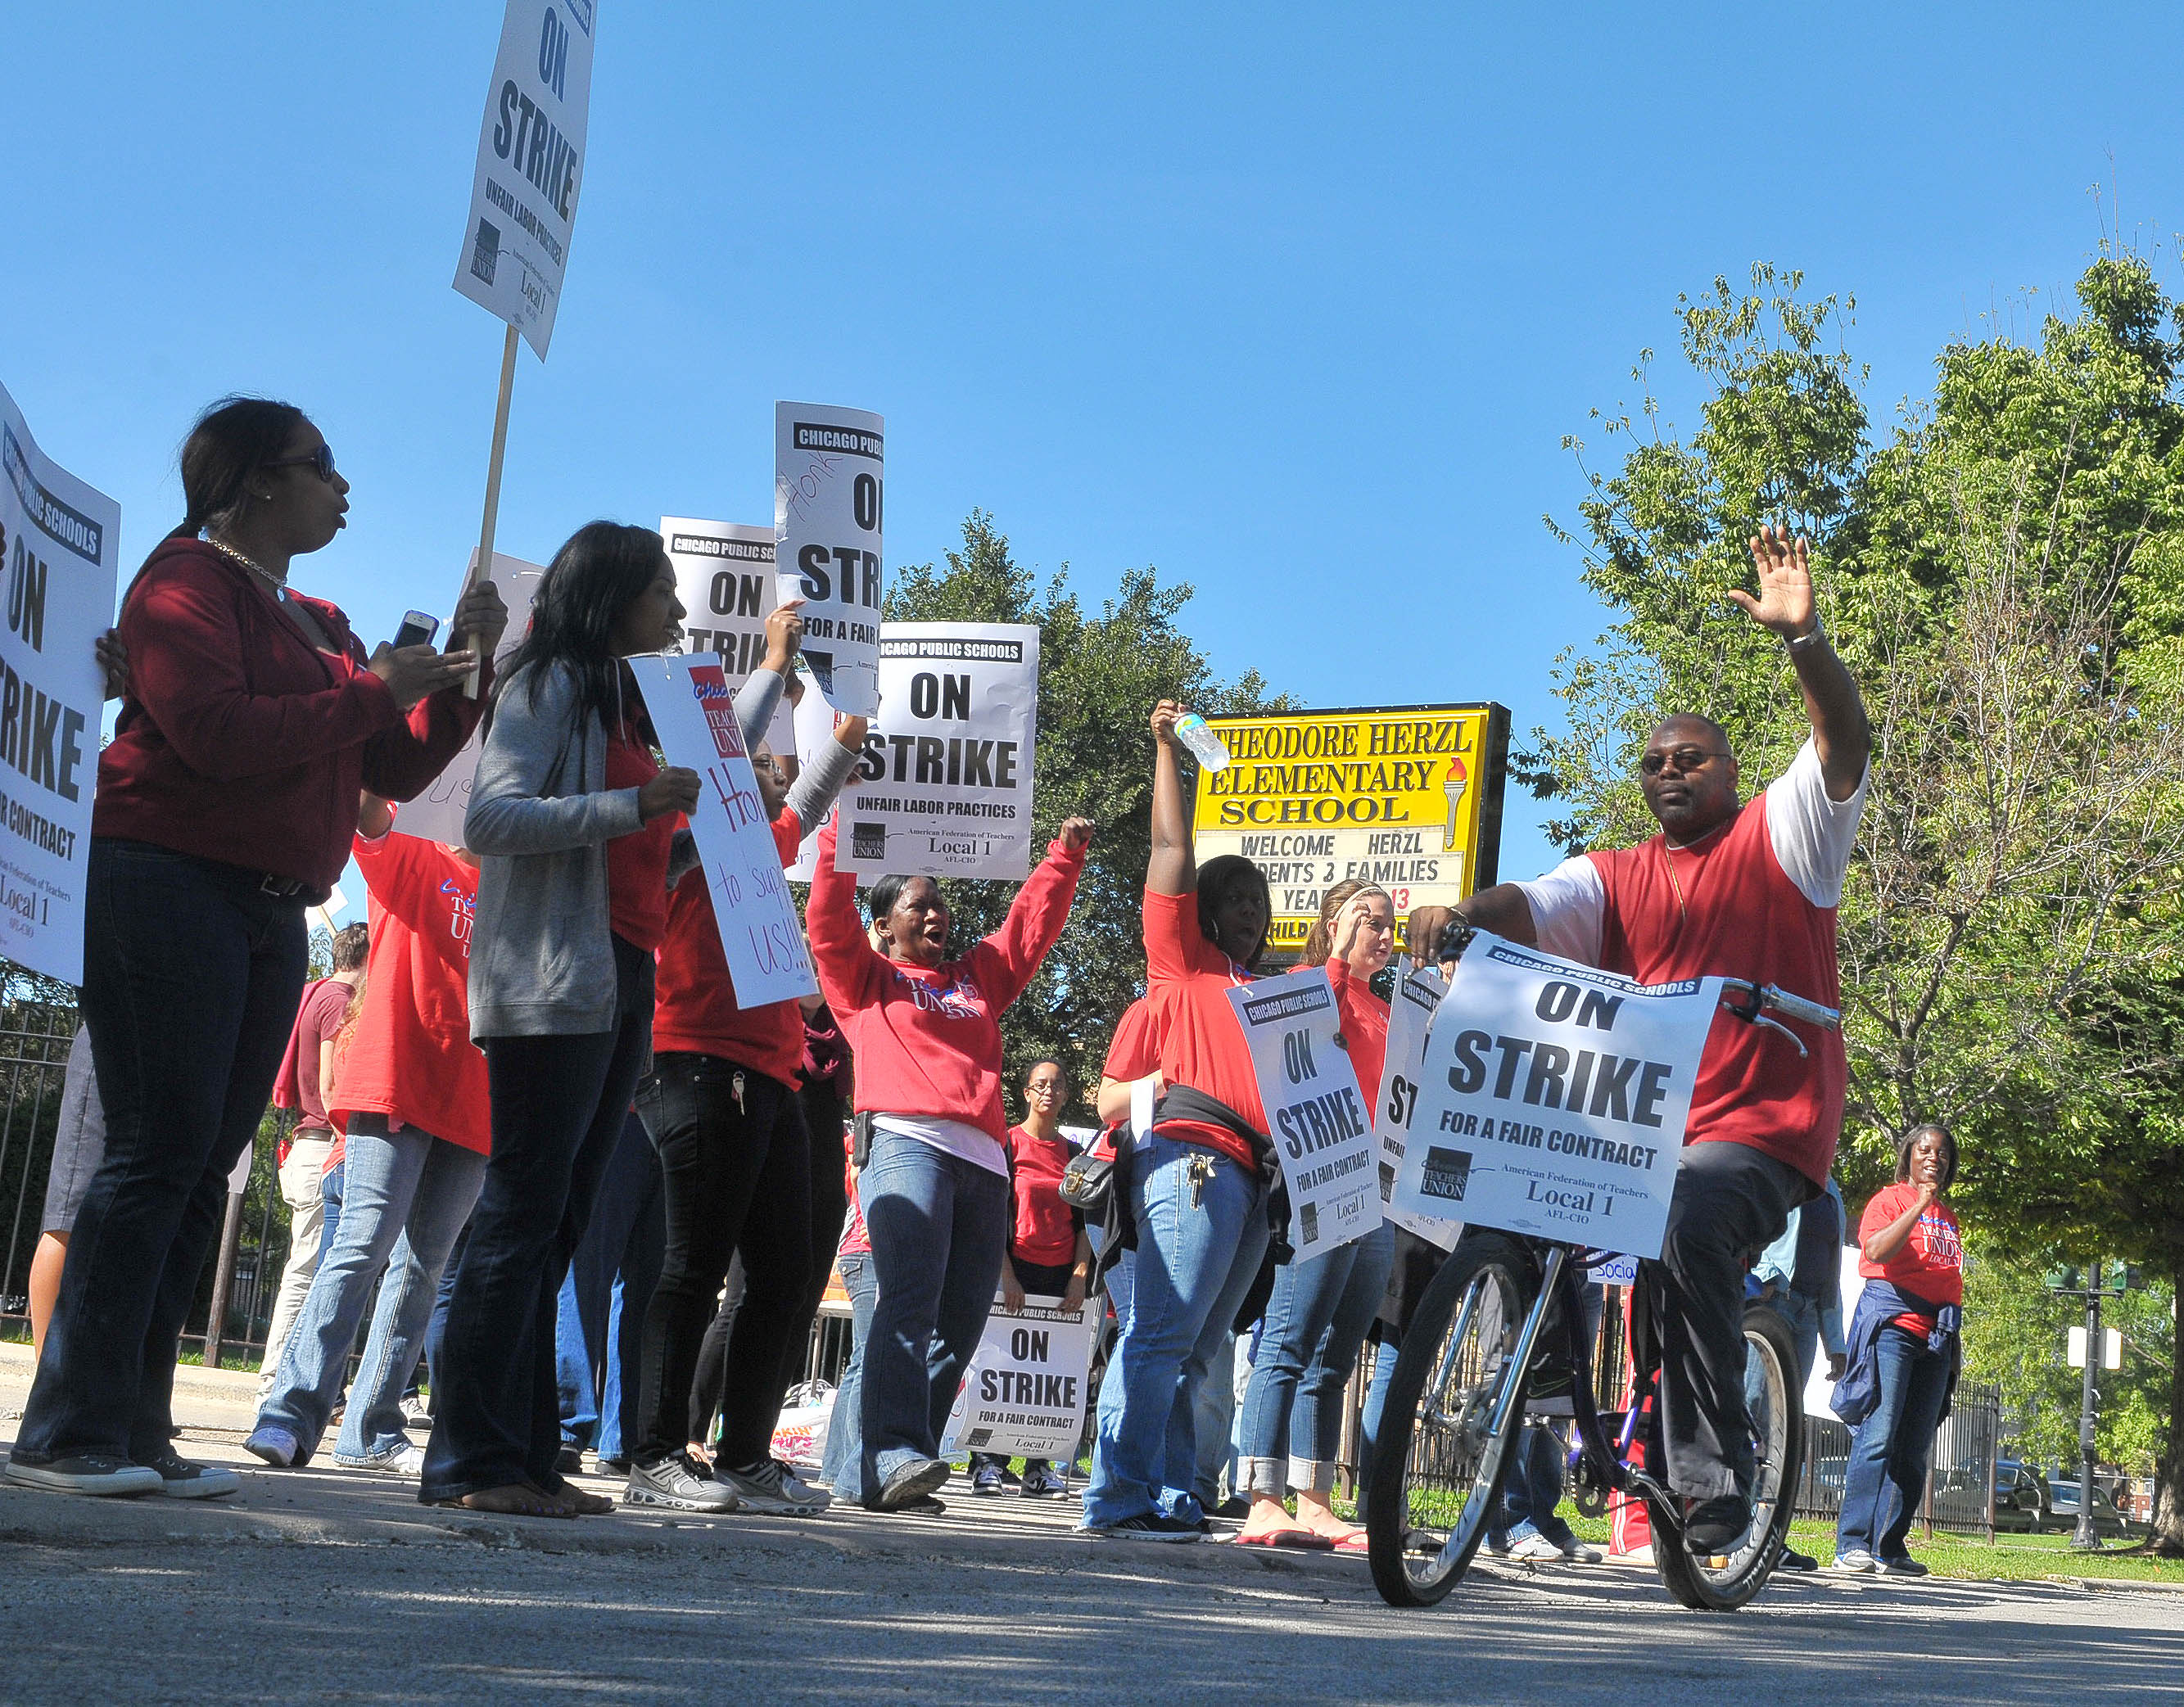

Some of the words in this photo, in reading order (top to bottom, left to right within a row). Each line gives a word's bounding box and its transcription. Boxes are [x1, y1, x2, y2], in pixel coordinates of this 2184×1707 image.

[538, 6, 570, 104] ON
[494, 79, 578, 223] STRIKE
[485, 177, 515, 218] UNFAIR
[513, 201, 537, 237] LABOR
[521, 269, 543, 310] Local
[540, 293, 547, 314] 1
[799, 429, 858, 450] CHICAGO
[860, 436, 883, 458] PUBL
[777, 450, 845, 522] Honk
[44, 502, 97, 556] SCHOOLS
[674, 537, 720, 555] CHICAGO
[721, 544, 759, 559] PUBLIC
[8, 534, 47, 654] ON
[709, 571, 764, 618] ON
[798, 544, 883, 611] STR
[803, 616, 834, 638] FOR
[836, 621, 847, 639] A
[851, 622, 875, 645] FAIR
[880, 642, 917, 656] ICAGO
[919, 642, 962, 657] PUBLIC
[963, 644, 1019, 659] SCHOOLS
[910, 672, 971, 720] ON
[0, 660, 85, 803] RIKE
[1214, 724, 1359, 760] THEODORE
[1368, 720, 1473, 756] HERZL
[861, 733, 1018, 788] STRIKE
[1208, 760, 1438, 796] ELEMENTARY
[708, 762, 766, 833] Hon
[857, 797, 902, 813] UNFAIR
[903, 799, 945, 815] LABOR
[947, 802, 1016, 820] PRACTICES
[1220, 796, 1410, 825] SCHOOL
[10, 799, 76, 862] CONTRACT
[907, 828, 940, 837] American
[941, 829, 977, 838] Federation
[986, 832, 1015, 840] Teachers
[929, 837, 977, 855] Local
[983, 840, 992, 856] 1
[1241, 835, 1336, 857] WELCOME
[1368, 832, 1423, 855] HERZL
[853, 847, 884, 858] UNION
[1255, 861, 1315, 884] DENTS
[1345, 859, 1439, 883] FAMILIES
[0, 874, 37, 920] Local
[41, 897, 48, 927] 1
[715, 862, 741, 909] to
[752, 866, 792, 910] supp
[1494, 951, 1564, 973] CHICAGO
[1566, 969, 1622, 988] PUBLIC
[1623, 981, 1696, 996] SCHOOLS
[1248, 1001, 1282, 1022] CHICAGO
[1282, 995, 1304, 1014] PUBLIC
[1404, 982, 1431, 1009] CHICAGO
[1535, 981, 1626, 1032] ON
[1284, 1028, 1318, 1085] ON
[1448, 1030, 1673, 1128] STRIKE
[1276, 1086, 1365, 1160] STRIKE
[1439, 1109, 1477, 1137] FOR
[1481, 1119, 1495, 1140] A
[1499, 1121, 1544, 1147] FAIR
[1547, 1129, 1658, 1171] CONTRACT
[1296, 1172, 1312, 1193] FOR
[1311, 1169, 1319, 1187] A
[1318, 1163, 1335, 1185] FAIR
[1334, 1149, 1370, 1179] CONTRACT
[1421, 1180, 1465, 1198] UNION
[1424, 1169, 1467, 1184] TEACHERS
[1502, 1163, 1545, 1180] American
[1547, 1171, 1596, 1189] Federation
[1597, 1181, 1610, 1191] of
[1608, 1183, 1649, 1199] Teachers
[1336, 1195, 1359, 1220] Local
[1360, 1194, 1366, 1209] 1
[1526, 1179, 1594, 1213] Local
[1601, 1195, 1613, 1217] 1
[1545, 1208, 1589, 1226] AFL-CIO
[1923, 1235, 1964, 1258] UNION
[1929, 1253, 1951, 1266] LOCAL
[1047, 1310, 1081, 1322] SCHOOLS
[1011, 1328, 1049, 1362] ON
[980, 1369, 1077, 1408] STRIKE
[979, 1411, 997, 1422] FOR
[997, 1413, 1004, 1423] A
[1006, 1413, 1025, 1425] FAIR
[1027, 1415, 1074, 1429] CONTRACT
[1015, 1438, 1046, 1449] Local
[1047, 1441, 1055, 1450] 1
